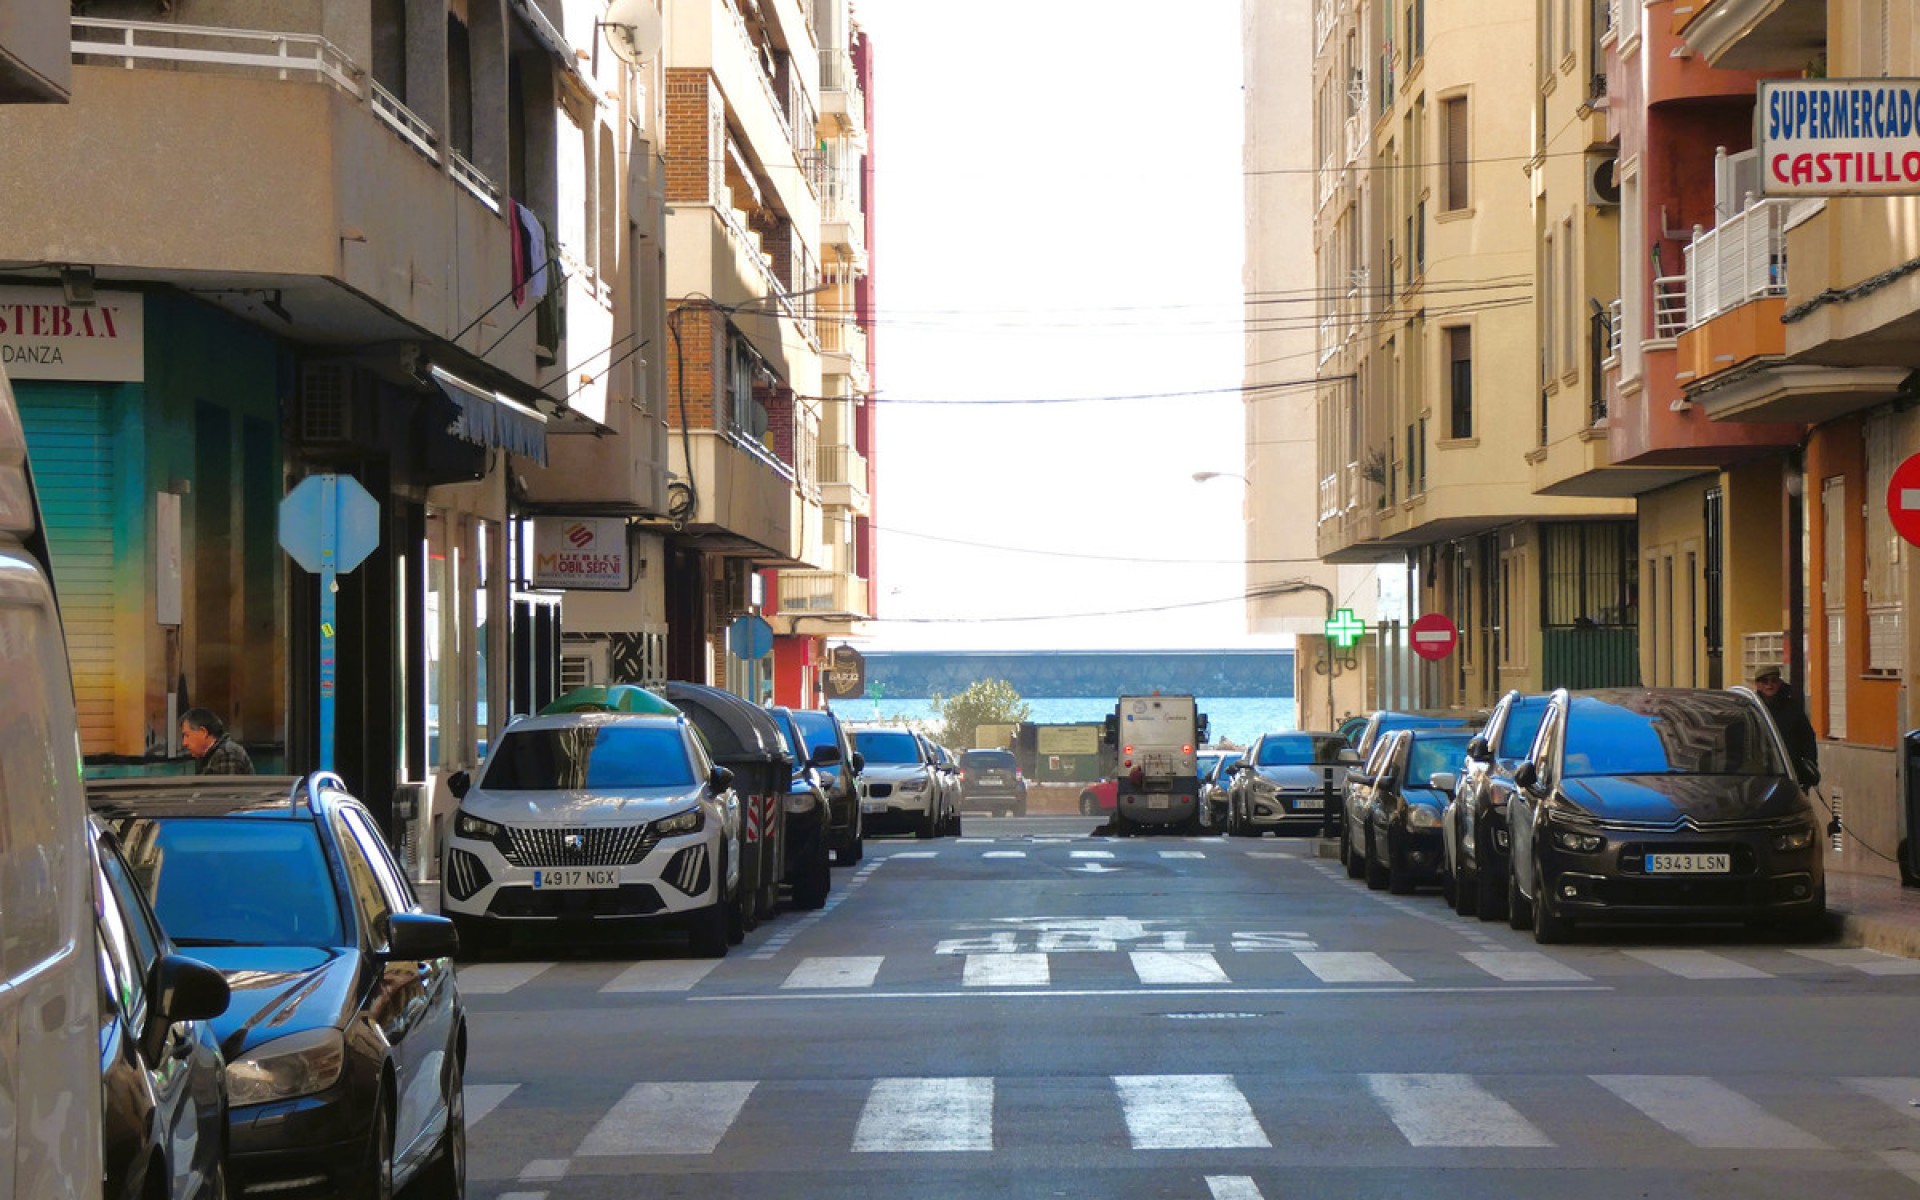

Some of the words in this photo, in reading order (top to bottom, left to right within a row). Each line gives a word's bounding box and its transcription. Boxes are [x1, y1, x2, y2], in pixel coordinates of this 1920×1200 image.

[1772, 151, 1920, 186] CASTILLO
[2, 344, 64, 364] DANZA
[1655, 855, 1692, 870] 5343
[1697, 855, 1726, 870] LSN
[544, 871, 582, 886] 4917
[586, 871, 614, 885] NGX
